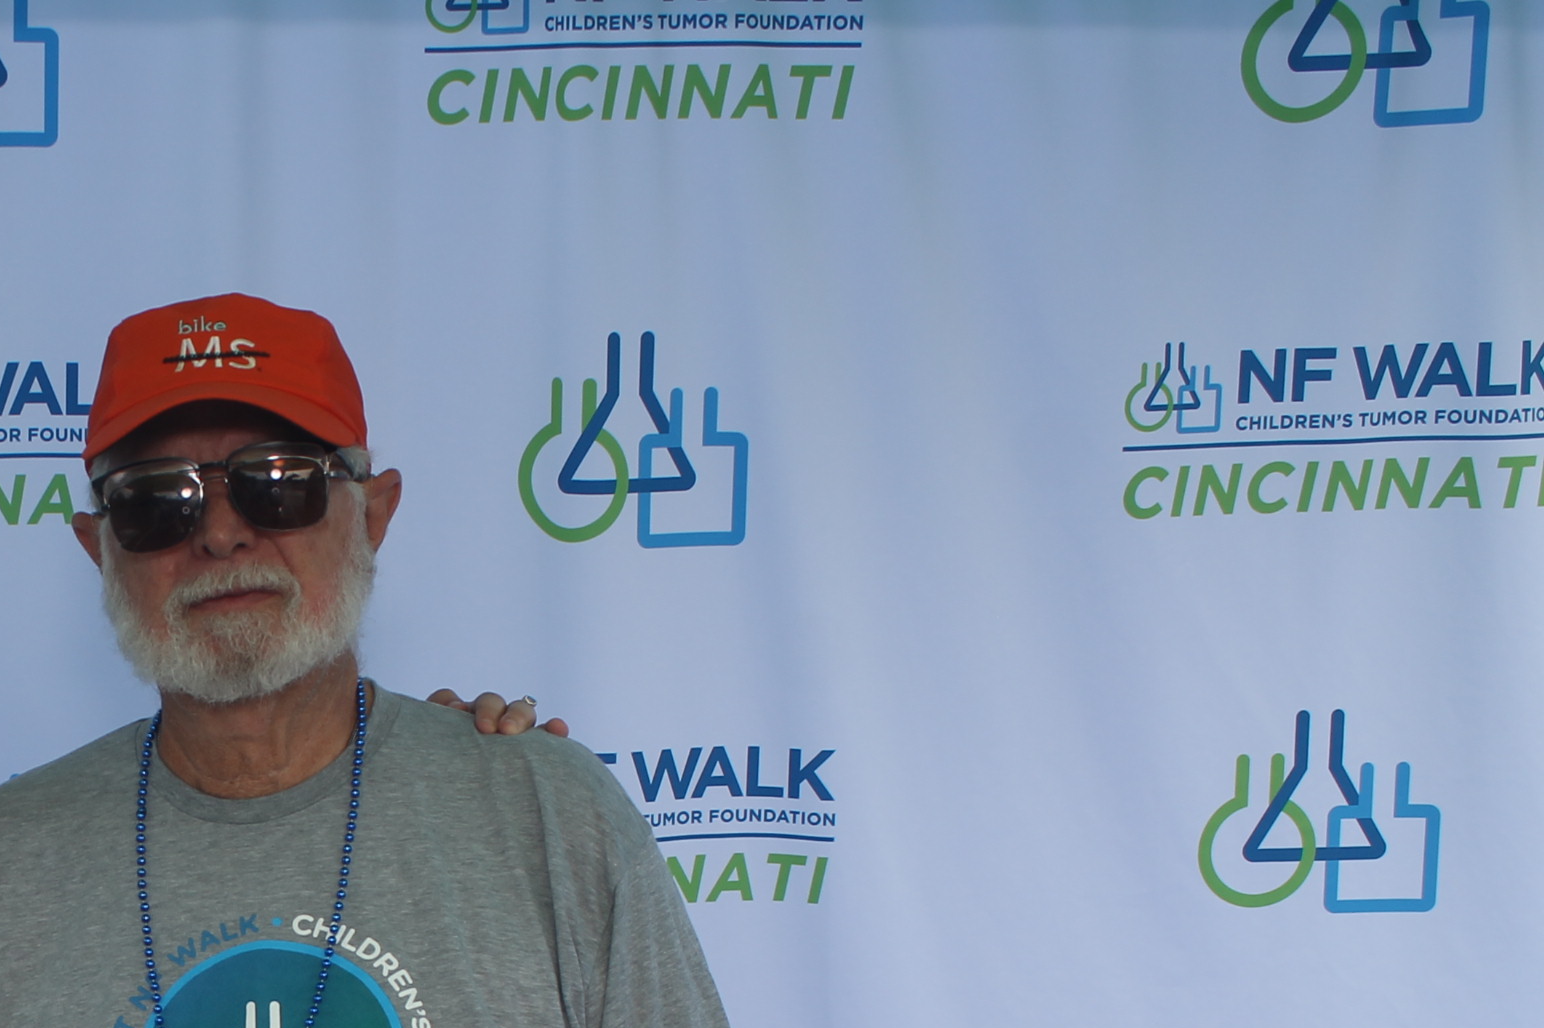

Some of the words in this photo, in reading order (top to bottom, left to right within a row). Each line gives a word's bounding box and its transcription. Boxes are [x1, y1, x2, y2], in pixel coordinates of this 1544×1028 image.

[545, 14, 653, 31] CHILDREN'S
[657, 14, 727, 29] TUMOR
[735, 14, 863, 30] FOUNDATION
[427, 64, 855, 125] CINCINNATI
[178, 316, 226, 334] bike
[174, 335, 256, 372] MS
[1238, 348, 1337, 404] NF
[1353, 340, 1544, 400] WALK
[1236, 414, 1352, 430] CHILDREN'S
[1359, 410, 1427, 427] TUMOR
[1435, 407, 1544, 424] FOUNDATIO
[1123, 456, 1544, 519] CINCINNAT
[631, 746, 835, 802] WALK
[709, 809, 835, 826] FOUNDATION
[166, 912, 260, 968] WALK
